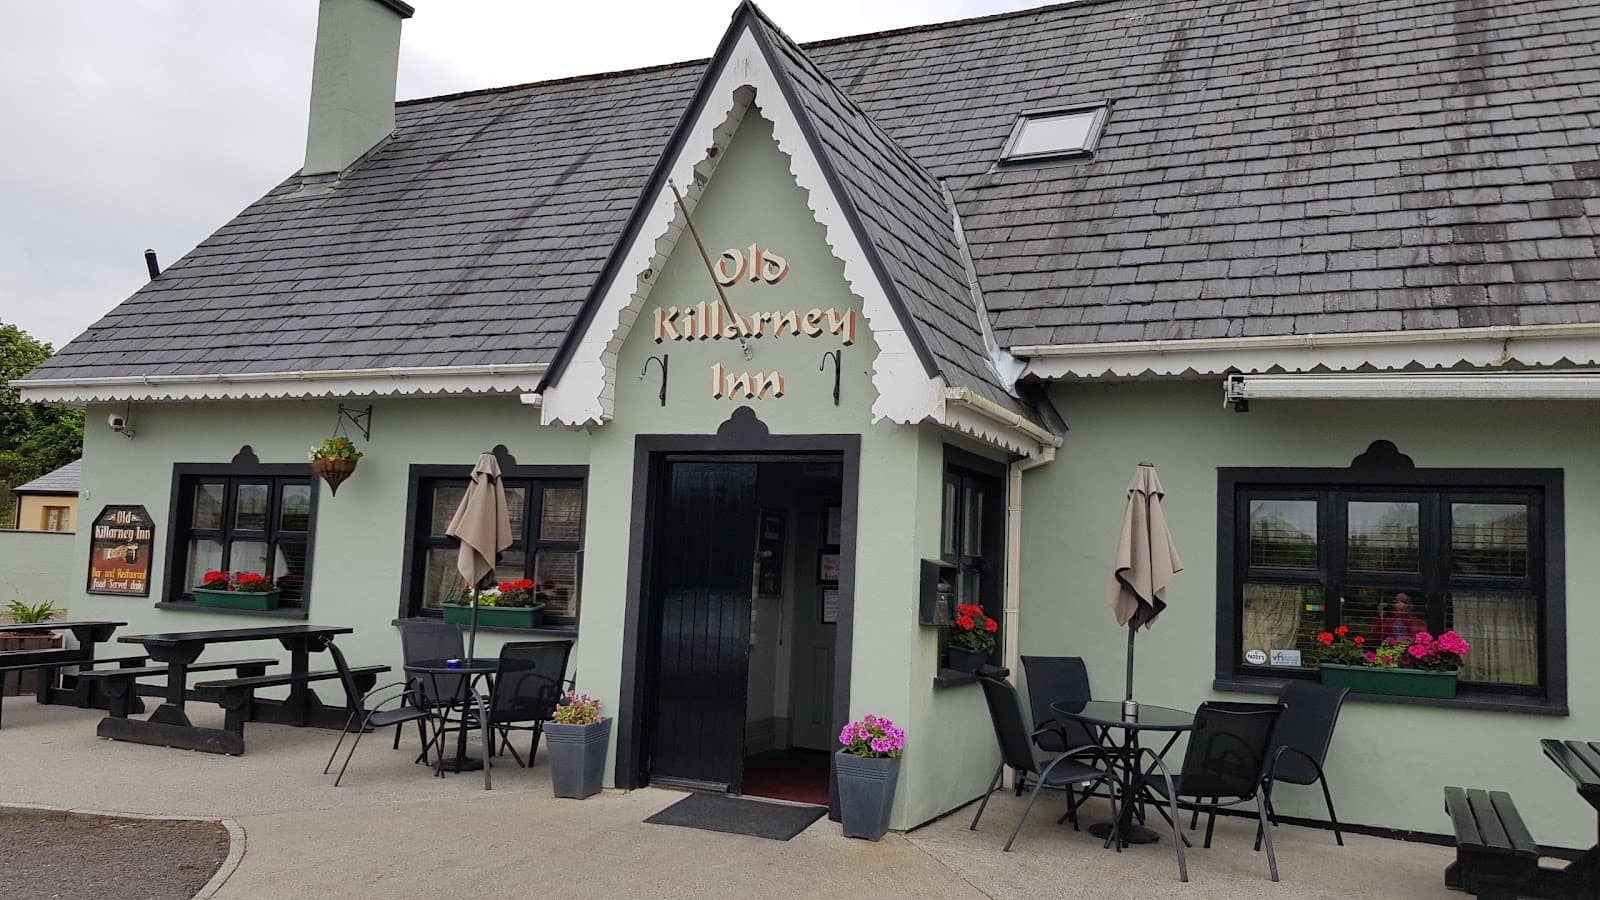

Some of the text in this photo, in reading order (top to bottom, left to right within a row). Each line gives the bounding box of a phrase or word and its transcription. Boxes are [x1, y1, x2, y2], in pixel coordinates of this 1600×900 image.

[714, 242, 790, 287] Old
[653, 299, 857, 346] Killarney
[711, 361, 785, 400] Inn
[117, 511, 132, 524] Old
[95, 525, 150, 542] Killarney Inn
[92, 567, 147, 579] Bar and Restaurant
[109, 579, 128, 590] Served
[130, 580, 144, 591] daily
